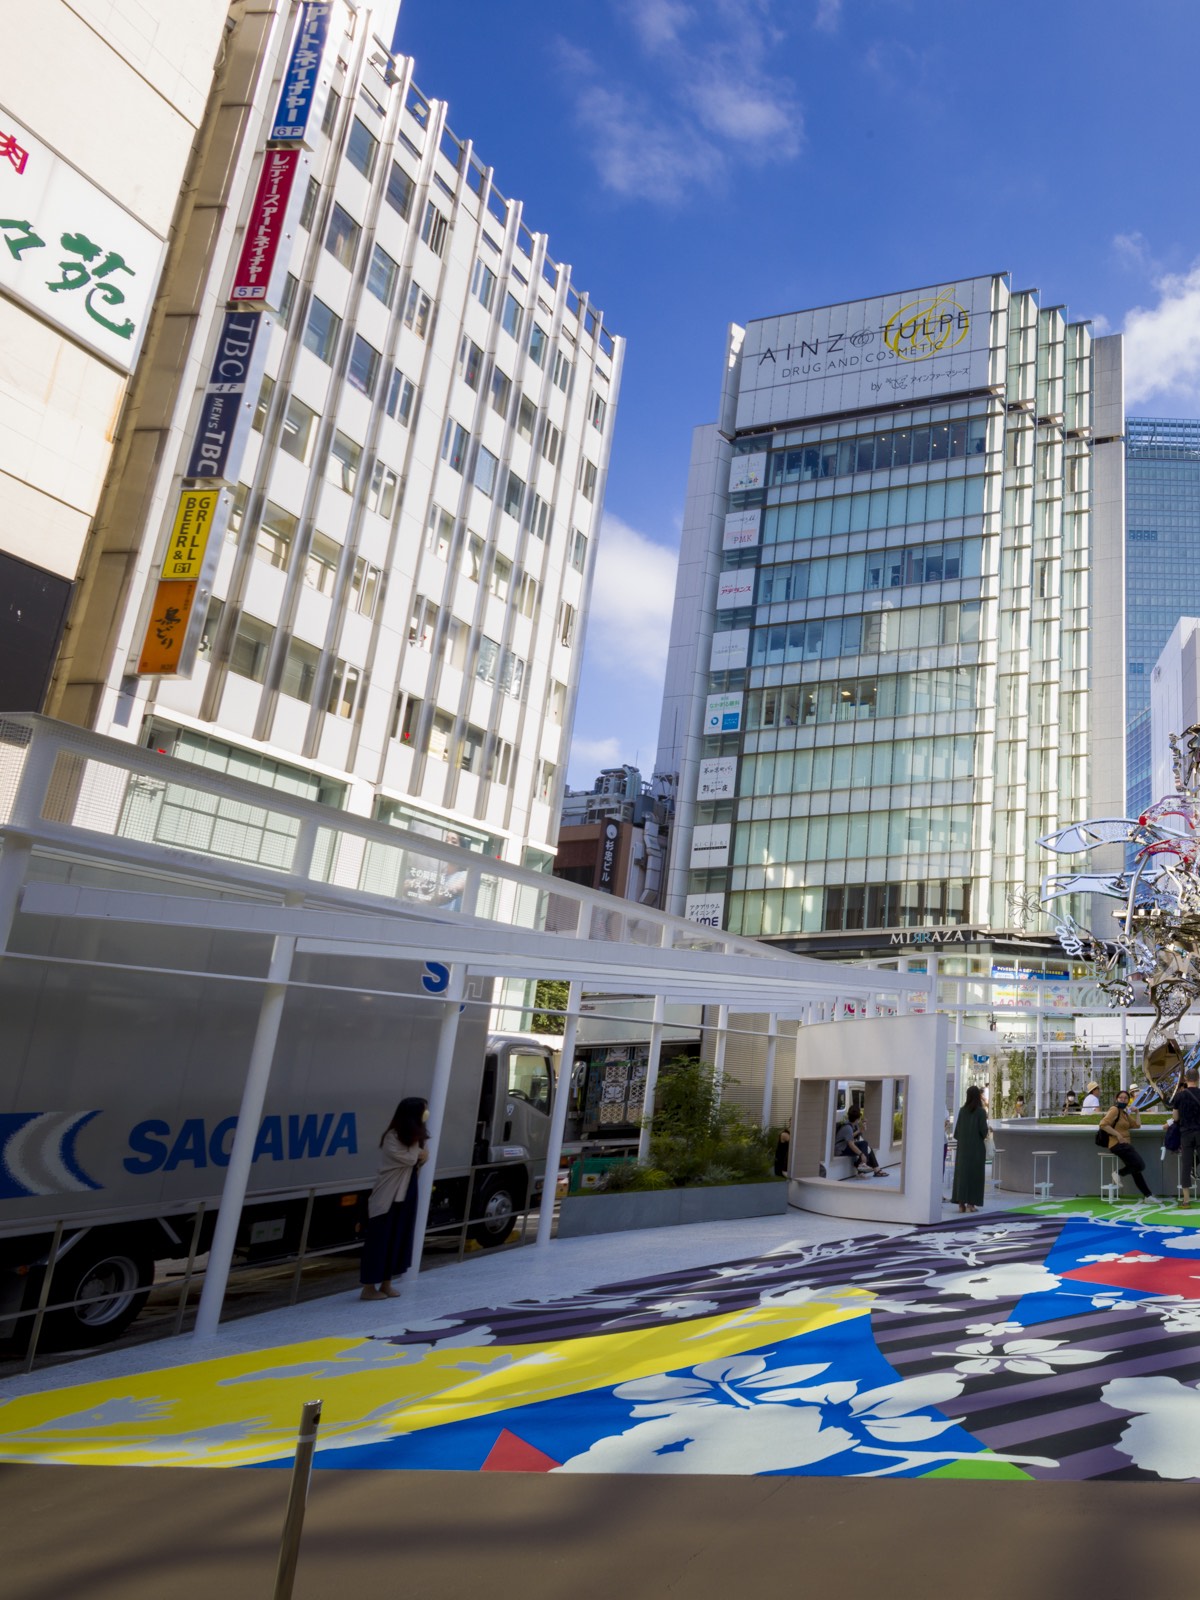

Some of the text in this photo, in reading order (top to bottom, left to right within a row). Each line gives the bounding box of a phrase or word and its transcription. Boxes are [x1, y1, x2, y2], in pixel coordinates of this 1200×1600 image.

[276, 126, 301, 137] 6F
[248, 153, 290, 283] レディースアートネイチャー
[237, 286, 263, 298] 5F
[218, 319, 257, 377] TBC
[759, 333, 845, 366] AINZ
[879, 310, 970, 343] TULPE
[781, 340, 943, 378] DRUG AND COSMETIC
[215, 384, 238, 392] 4F
[870, 381, 882, 391] by
[207, 397, 223, 428] MEN'S
[197, 430, 226, 475] TBC
[176, 497, 196, 548] BEER
[187, 497, 210, 561] GRILL
[172, 550, 183, 560] &
